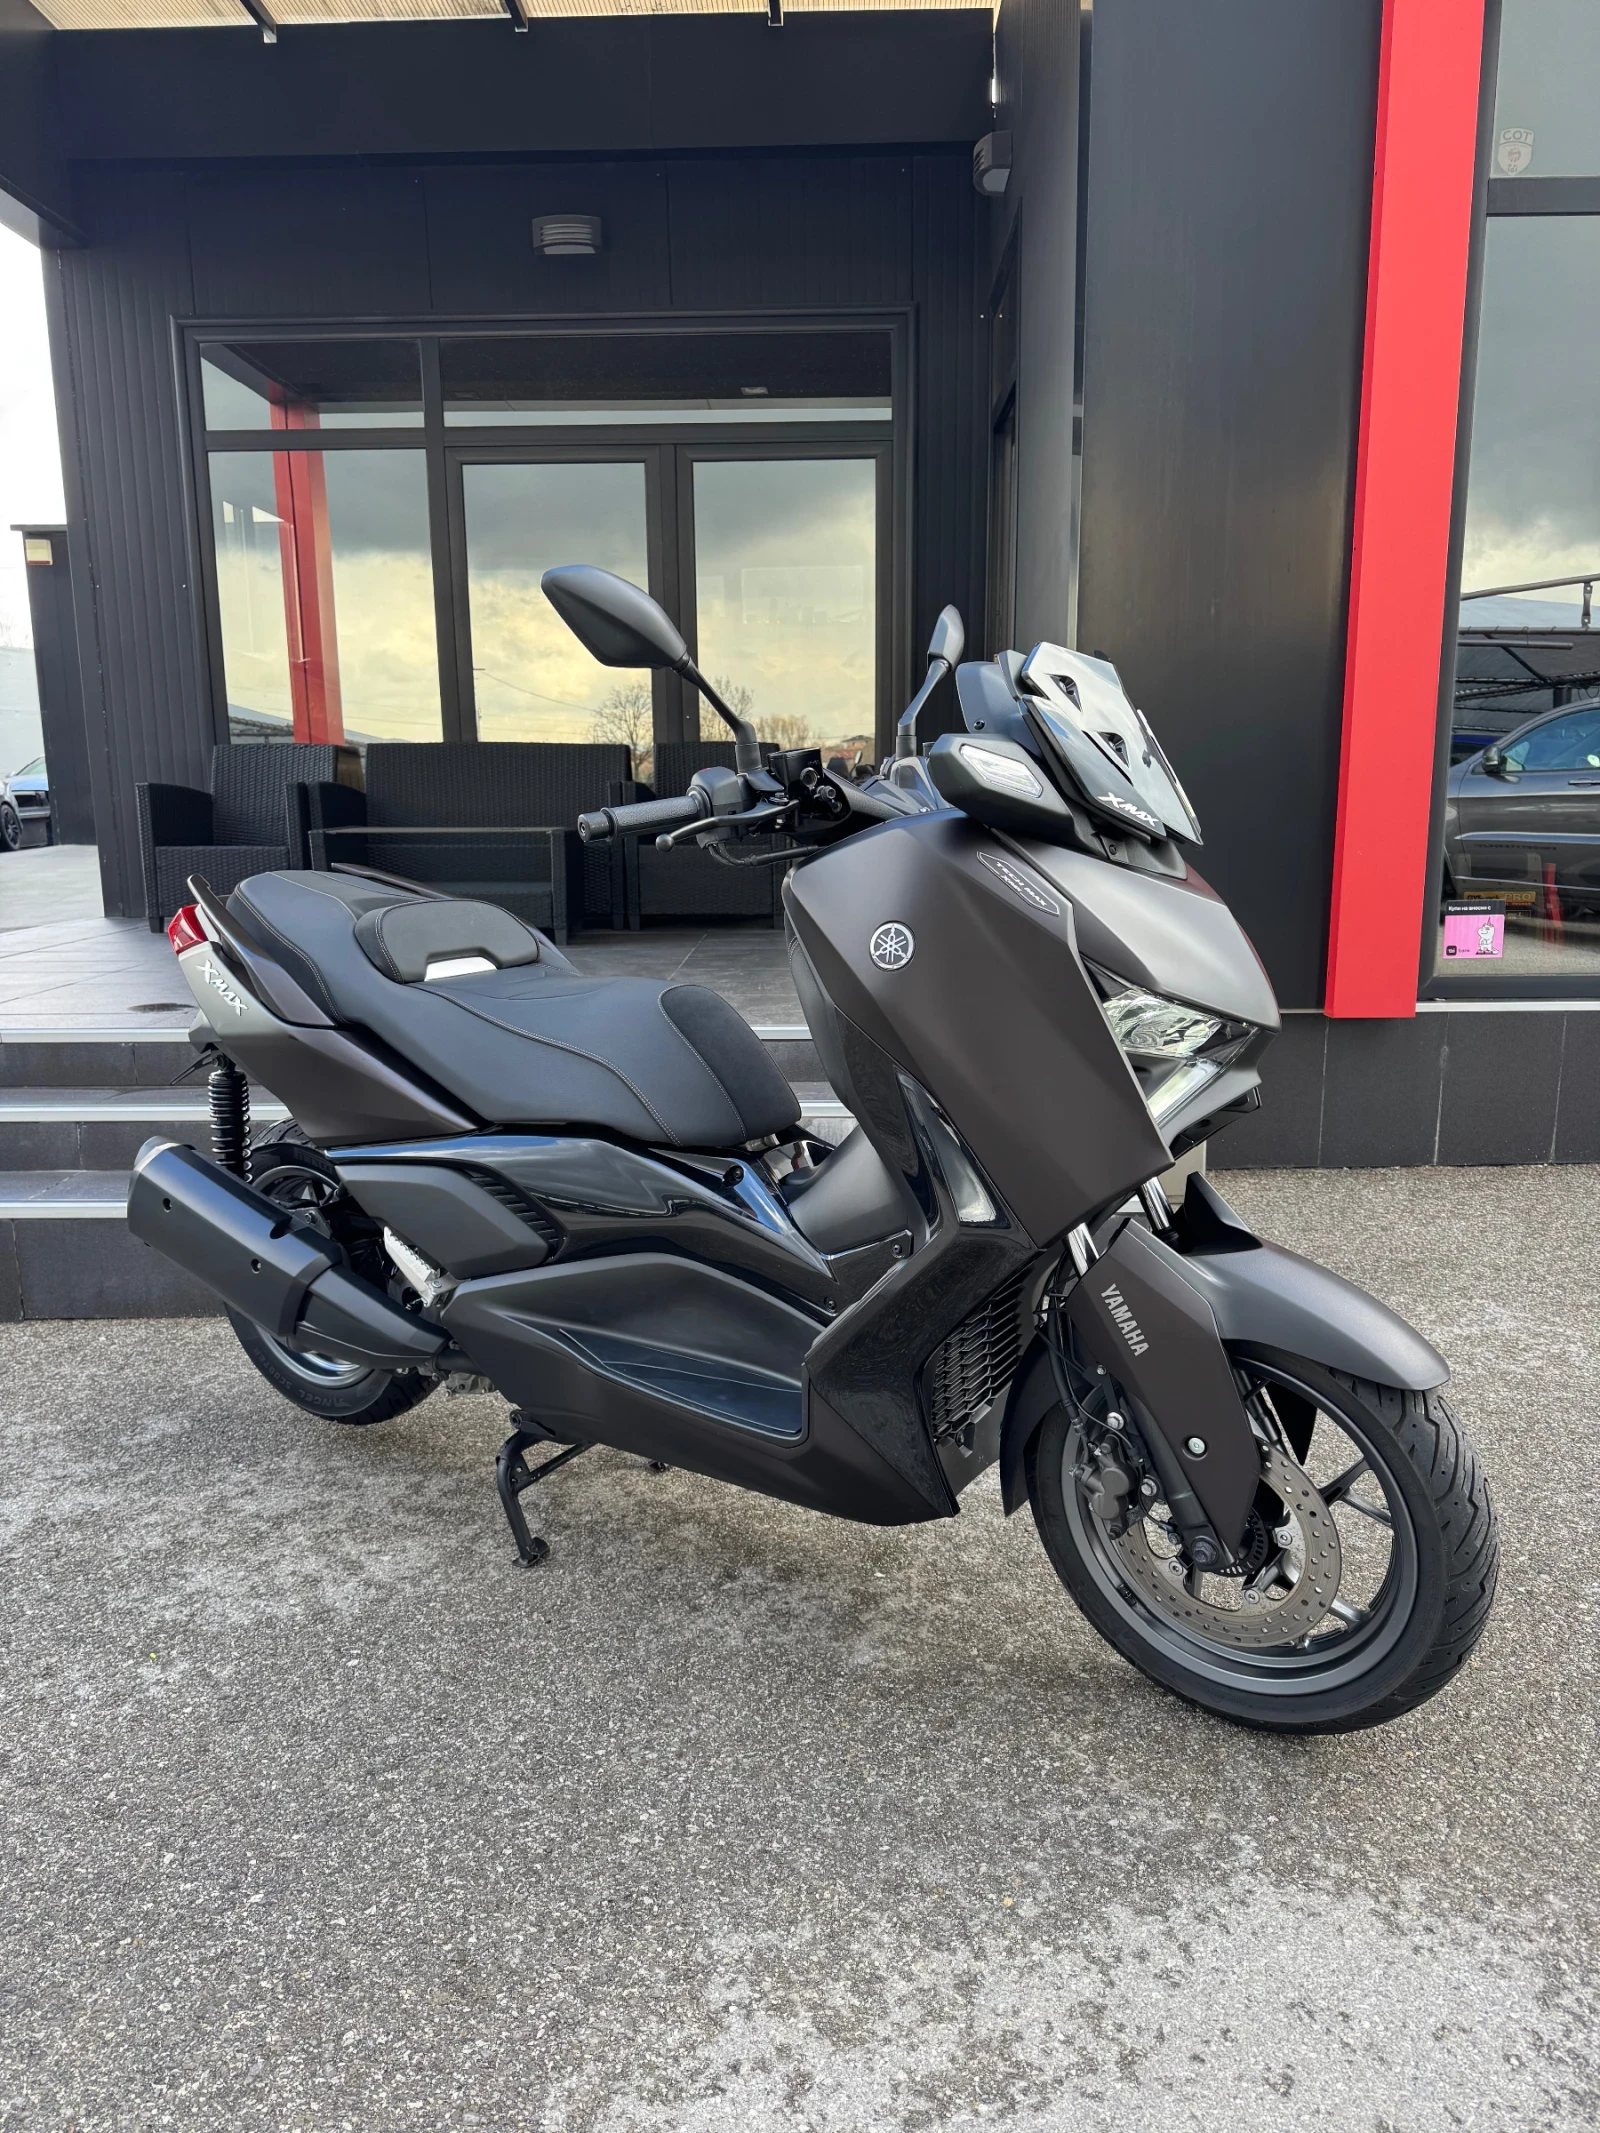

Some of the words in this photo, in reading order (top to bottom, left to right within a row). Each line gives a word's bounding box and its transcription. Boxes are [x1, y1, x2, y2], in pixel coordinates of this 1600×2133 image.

[1097, 791, 1159, 827] XMAX
[996, 861, 1024, 886] TECH
[1024, 887, 1047, 906] MAX
[1504, 893, 1532, 901] PRO
[195, 959, 249, 1016] XMAX
[1101, 1283, 1149, 1356] YAMAHA
[254, 1348, 293, 1390] SCOOTER
[297, 1389, 352, 1408] ANGEL
